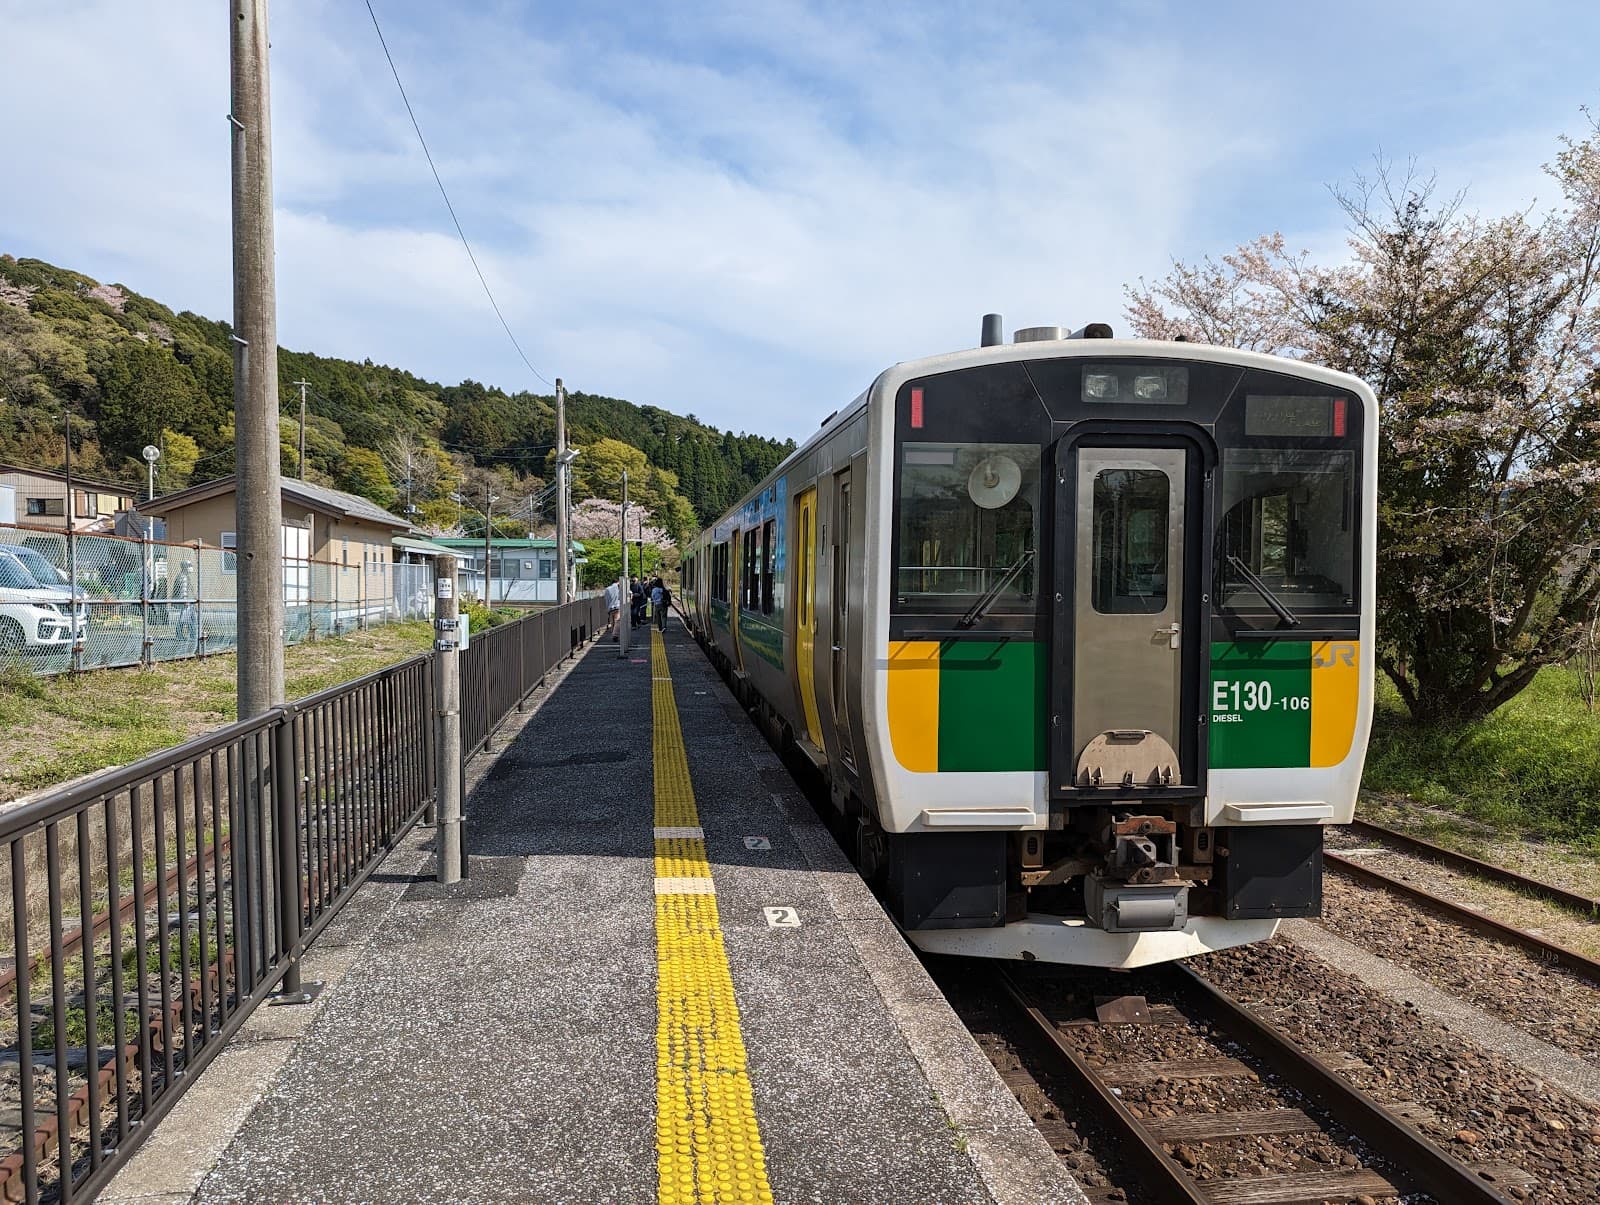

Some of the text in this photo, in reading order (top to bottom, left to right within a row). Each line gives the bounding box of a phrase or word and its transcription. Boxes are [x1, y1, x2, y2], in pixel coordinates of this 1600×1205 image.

[1313, 644, 1356, 667] JR
[1212, 714, 1243, 723] DIESEL
[771, 909, 793, 924] 2
